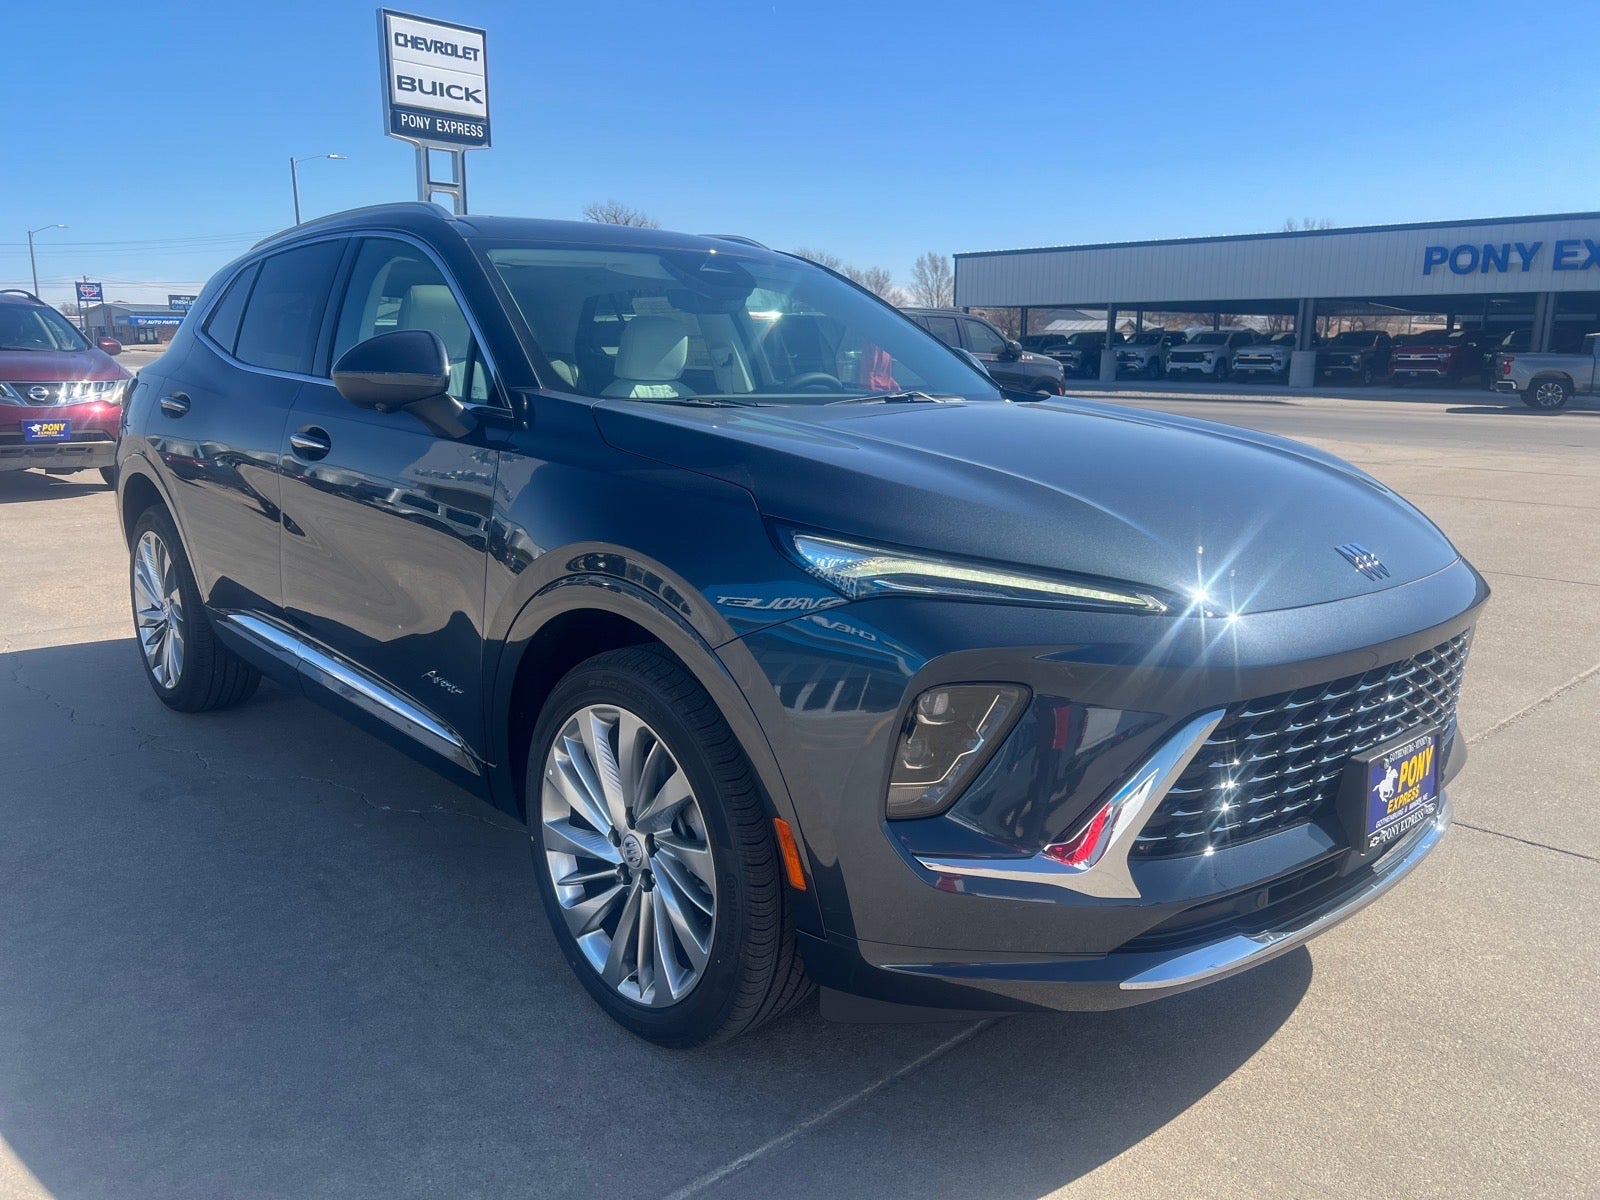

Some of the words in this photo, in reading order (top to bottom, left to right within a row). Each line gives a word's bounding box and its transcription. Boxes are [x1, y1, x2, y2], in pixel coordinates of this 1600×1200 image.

[394, 32, 480, 61] CHEVROLET
[396, 74, 484, 104] BUICK
[401, 113, 431, 130] PONY
[436, 119, 484, 138] EXPRESS
[1423, 241, 1543, 275] PONY
[42, 423, 66, 431] PONY
[1397, 745, 1434, 793] PONY
[1387, 785, 1420, 814] EXPRESS
